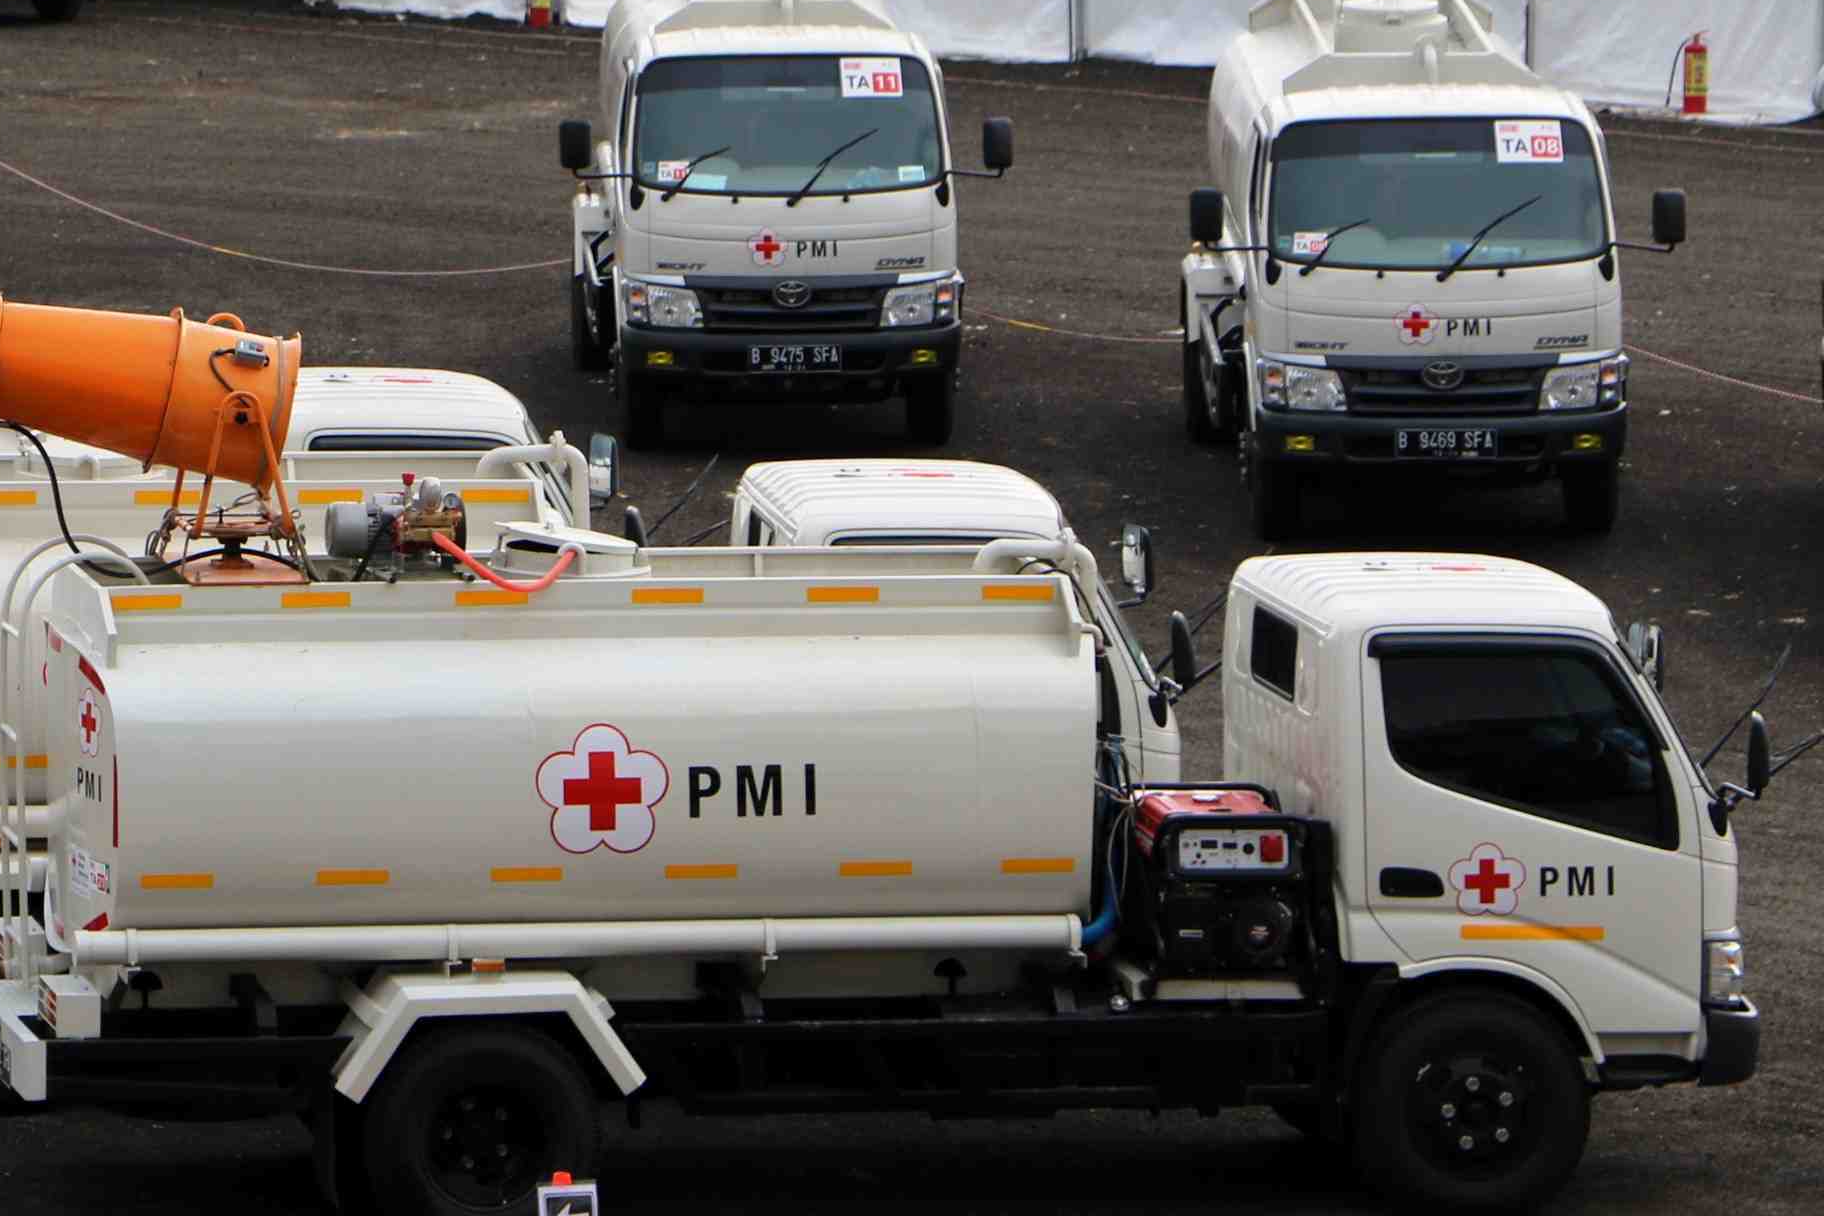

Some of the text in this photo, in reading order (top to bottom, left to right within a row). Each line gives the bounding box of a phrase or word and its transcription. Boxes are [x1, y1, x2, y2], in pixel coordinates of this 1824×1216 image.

[846, 75, 898, 91] TA 11
[1502, 138, 1528, 153] TA
[797, 239, 838, 257] PMI
[1447, 318, 1492, 336] PMI
[751, 346, 839, 365] B 9475 SFA
[1398, 432, 1494, 449] B 9469 SFA
[77, 767, 102, 803] PMI
[688, 763, 817, 819] PMI
[1539, 865, 1616, 897] PMI
